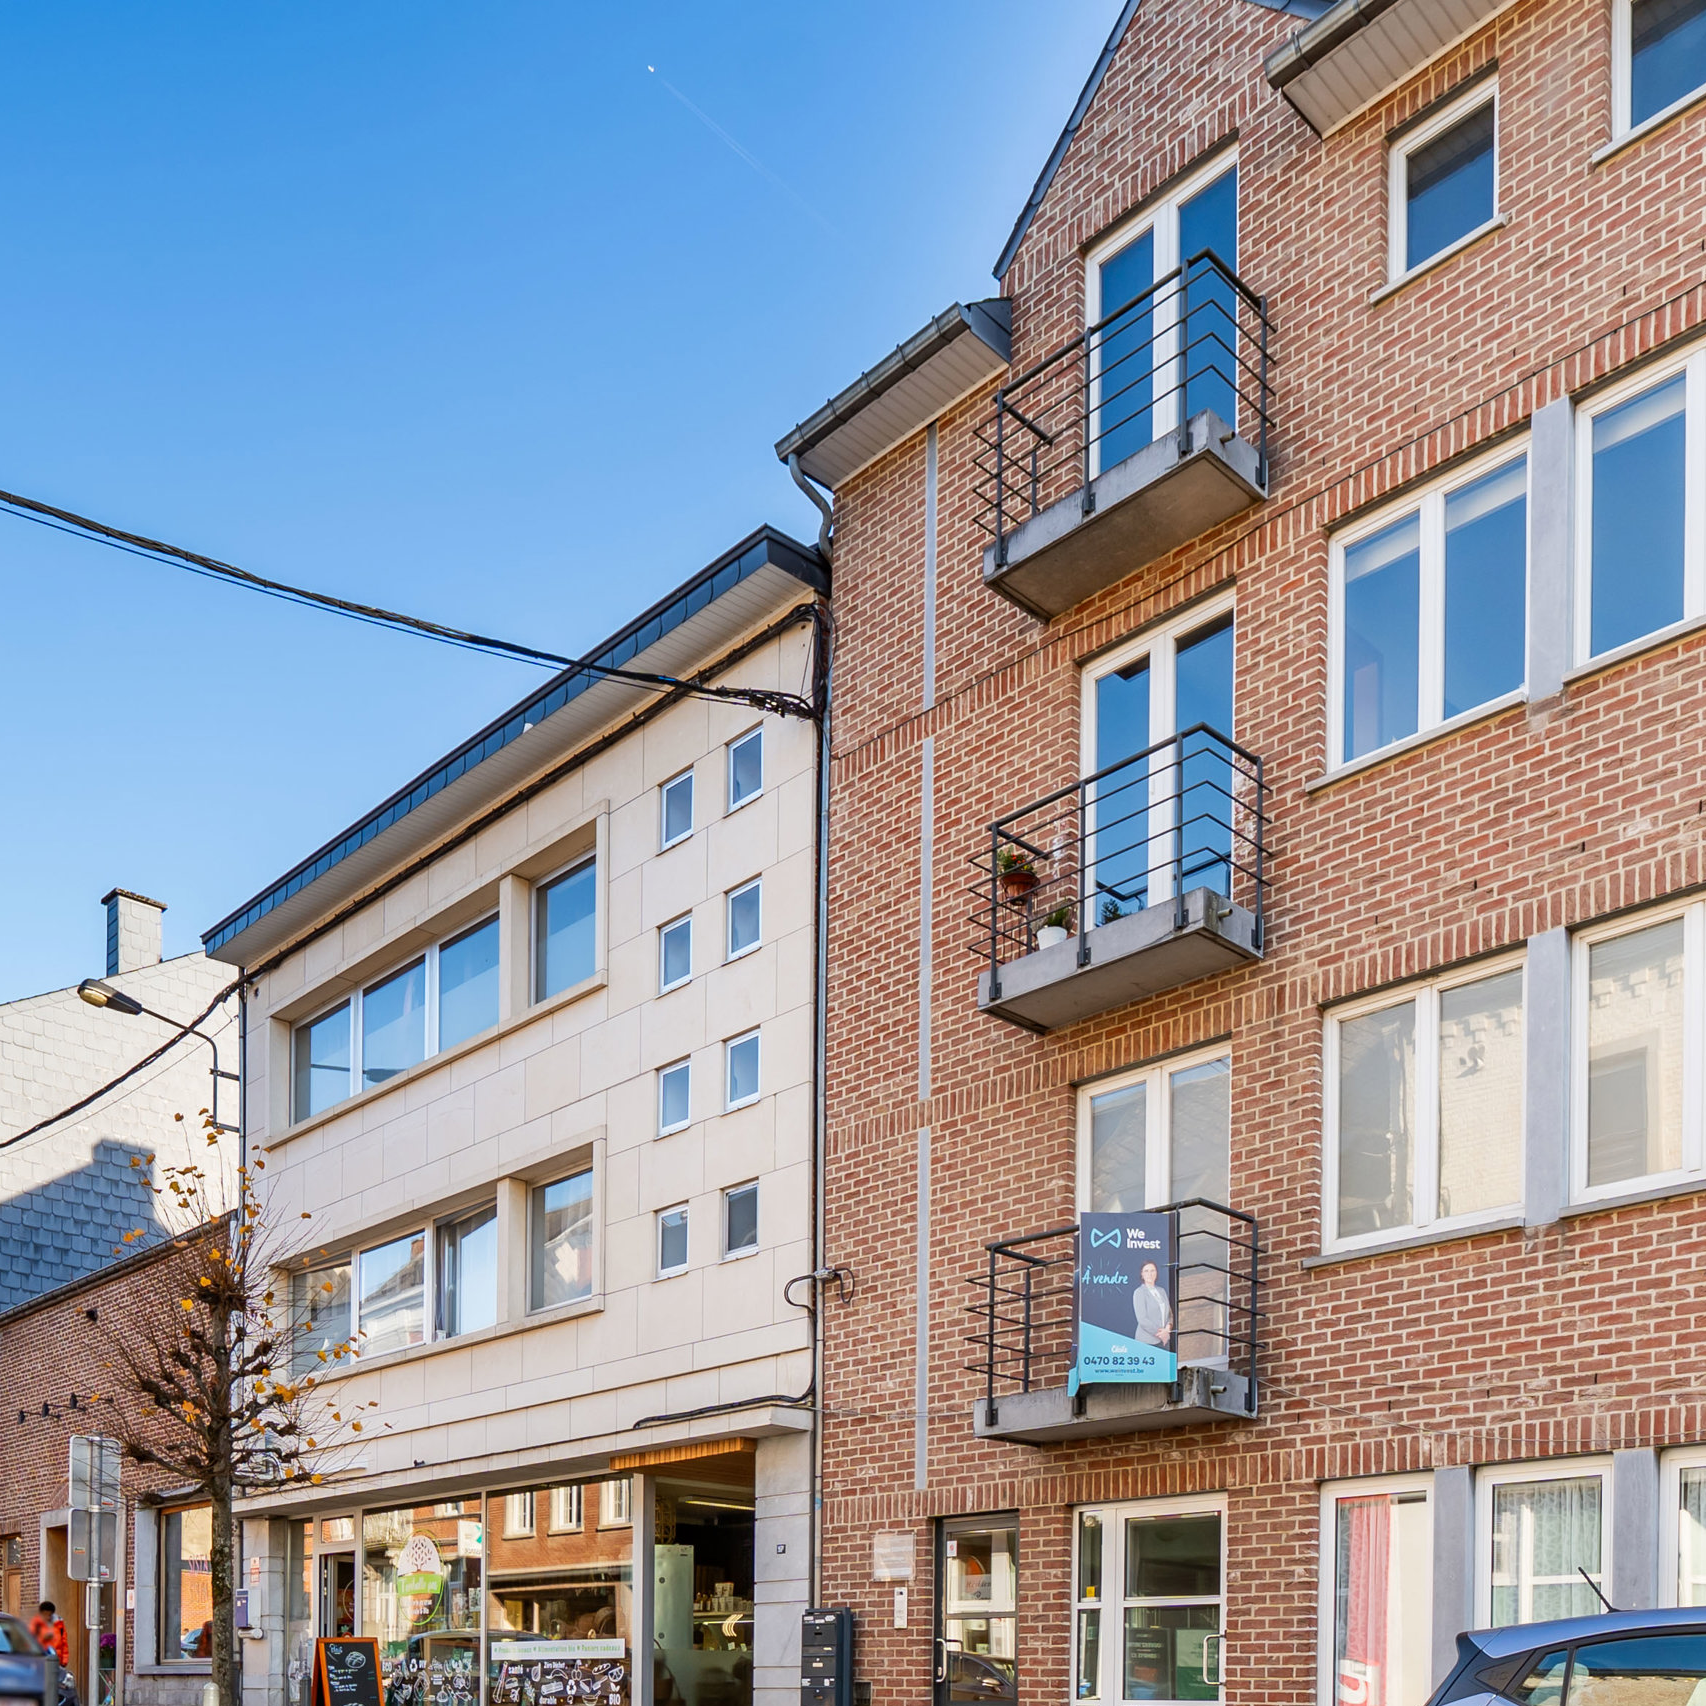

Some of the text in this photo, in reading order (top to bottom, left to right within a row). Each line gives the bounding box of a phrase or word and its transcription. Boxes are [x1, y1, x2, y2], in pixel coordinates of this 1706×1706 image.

[1126, 1228, 1145, 1239] We
[1126, 1238, 1161, 1249] Invest
[1081, 1265, 1129, 1285] À vendre
[1083, 1356, 1155, 1366] 0470 82 39 43
[609, 1694, 621, 1705] BIO
